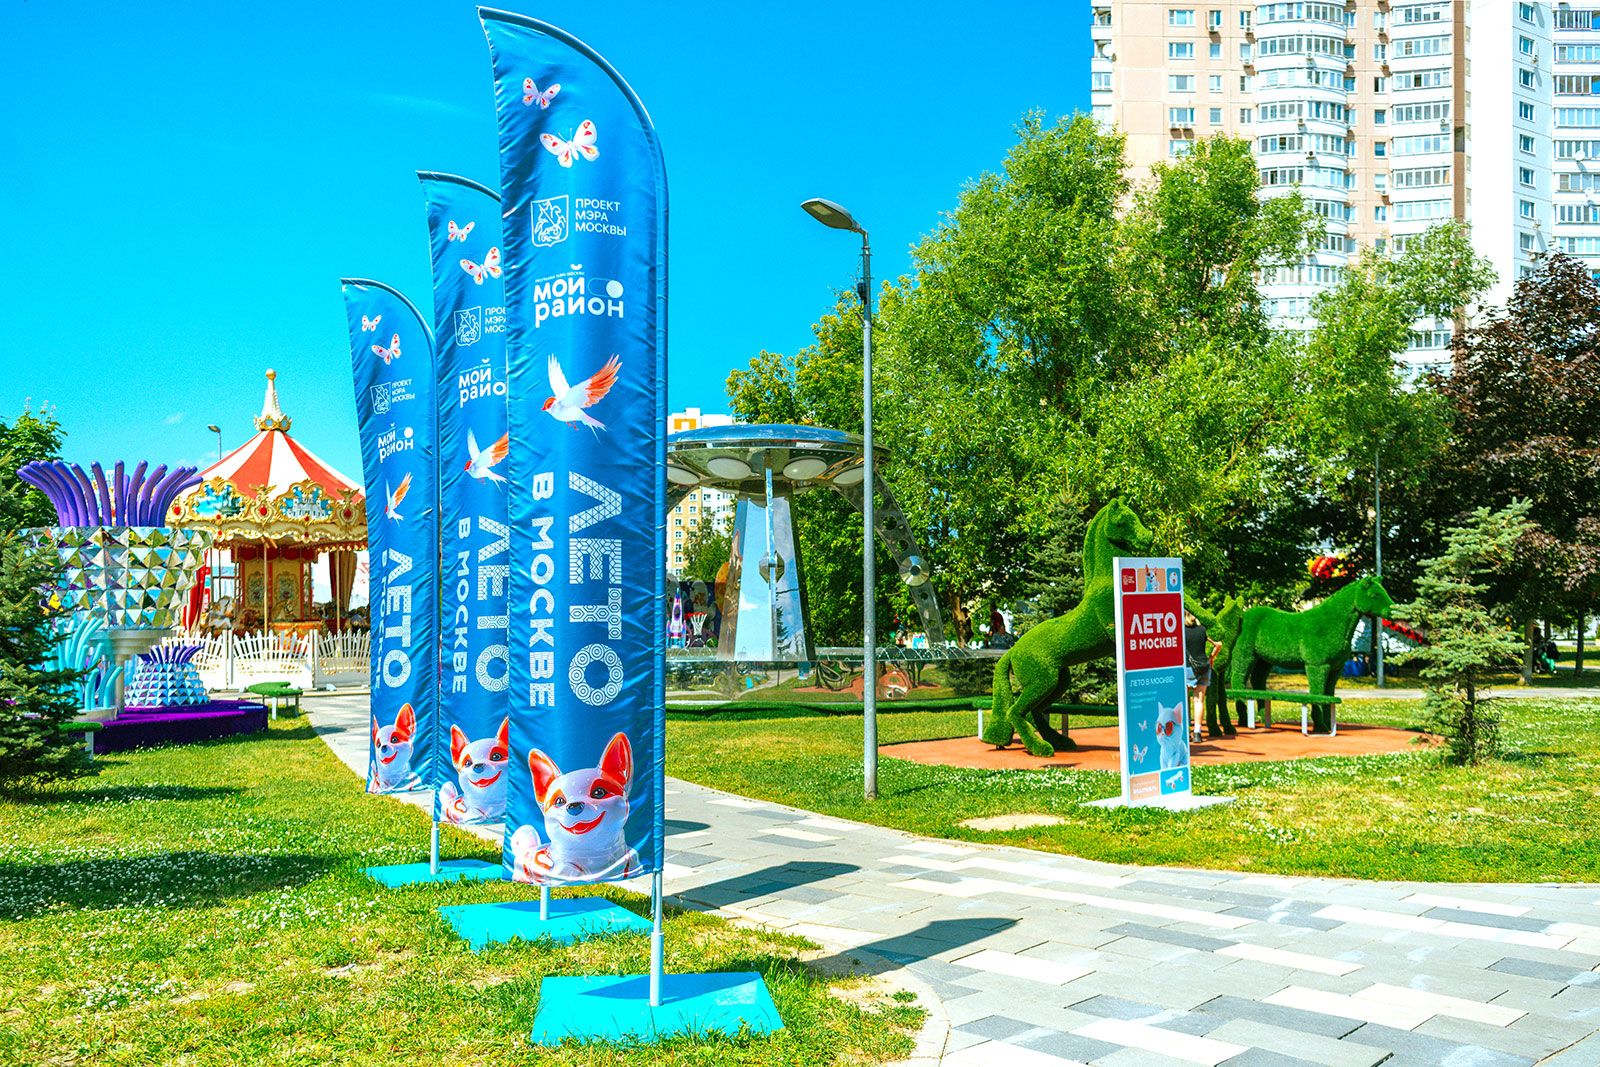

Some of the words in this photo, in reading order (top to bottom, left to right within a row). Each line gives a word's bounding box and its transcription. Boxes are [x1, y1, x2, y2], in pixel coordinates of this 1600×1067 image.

[575, 198, 621, 212] ПРОЕКТ
[575, 210, 608, 222] МЭРА
[575, 222, 627, 236] МОСКВЫ
[533, 264, 585, 303] мой
[485, 316, 506, 325] МЭР
[485, 325, 505, 334] МОС
[458, 358, 492, 389] мой
[531, 472, 554, 500] В
[458, 517, 471, 540] В
[568, 470, 623, 707] ЛЕТО
[383, 547, 413, 688] ЛЕТО
[452, 550, 470, 693] МОСКВЕ
[529, 516, 555, 707] МОСКВЕ
[1130, 612, 1177, 635] ЛЕТО
[1130, 639, 1137, 650] В
[1139, 637, 1178, 650] МОСКВЕ
